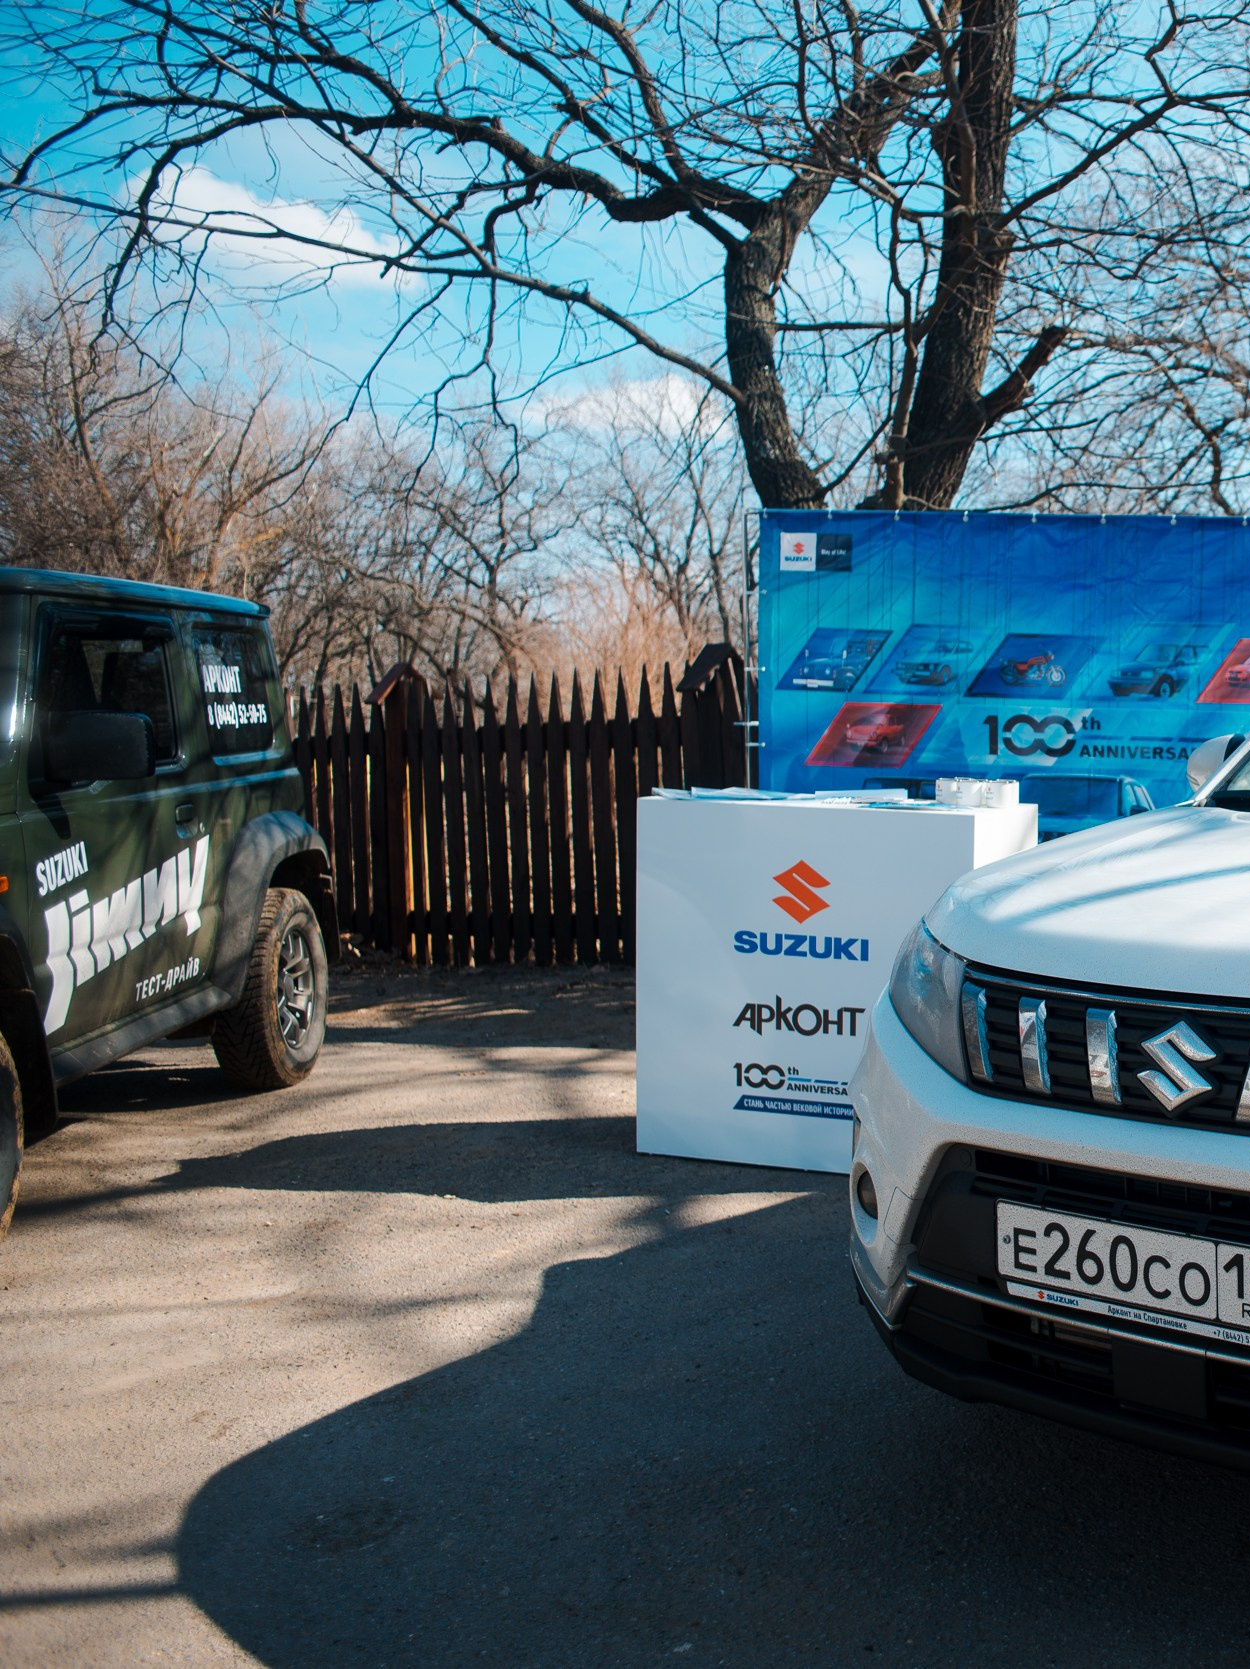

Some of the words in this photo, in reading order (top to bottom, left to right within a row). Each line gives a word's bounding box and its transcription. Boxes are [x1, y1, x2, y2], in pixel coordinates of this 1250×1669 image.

[202, 665, 241, 693] АРКОНТ
[207, 704, 215, 726] 8
[1079, 744, 1195, 760] ANNIVERSA
[35, 840, 89, 897] SUZUKI
[733, 930, 869, 962] SUZUKI
[135, 956, 200, 1002] ТЕСТ-ДРАЙВ
[786, 1083, 849, 1096] ANNIVERSA
[744, 1098, 764, 1109] СТАНЬ
[765, 1101, 792, 1111] ЧАСТЬЮ
[793, 1103, 822, 1114] ВЕКОВОЙ
[823, 1106, 854, 1117] ИСТОРИИ
[1046, 1293, 1079, 1307] SUZUKI
[1133, 1312, 1142, 1321] на
[1143, 1312, 1188, 1330] Спартановке
[1213, 1329, 1221, 1337] +7
[1222, 1329, 1244, 1344] (8442)
